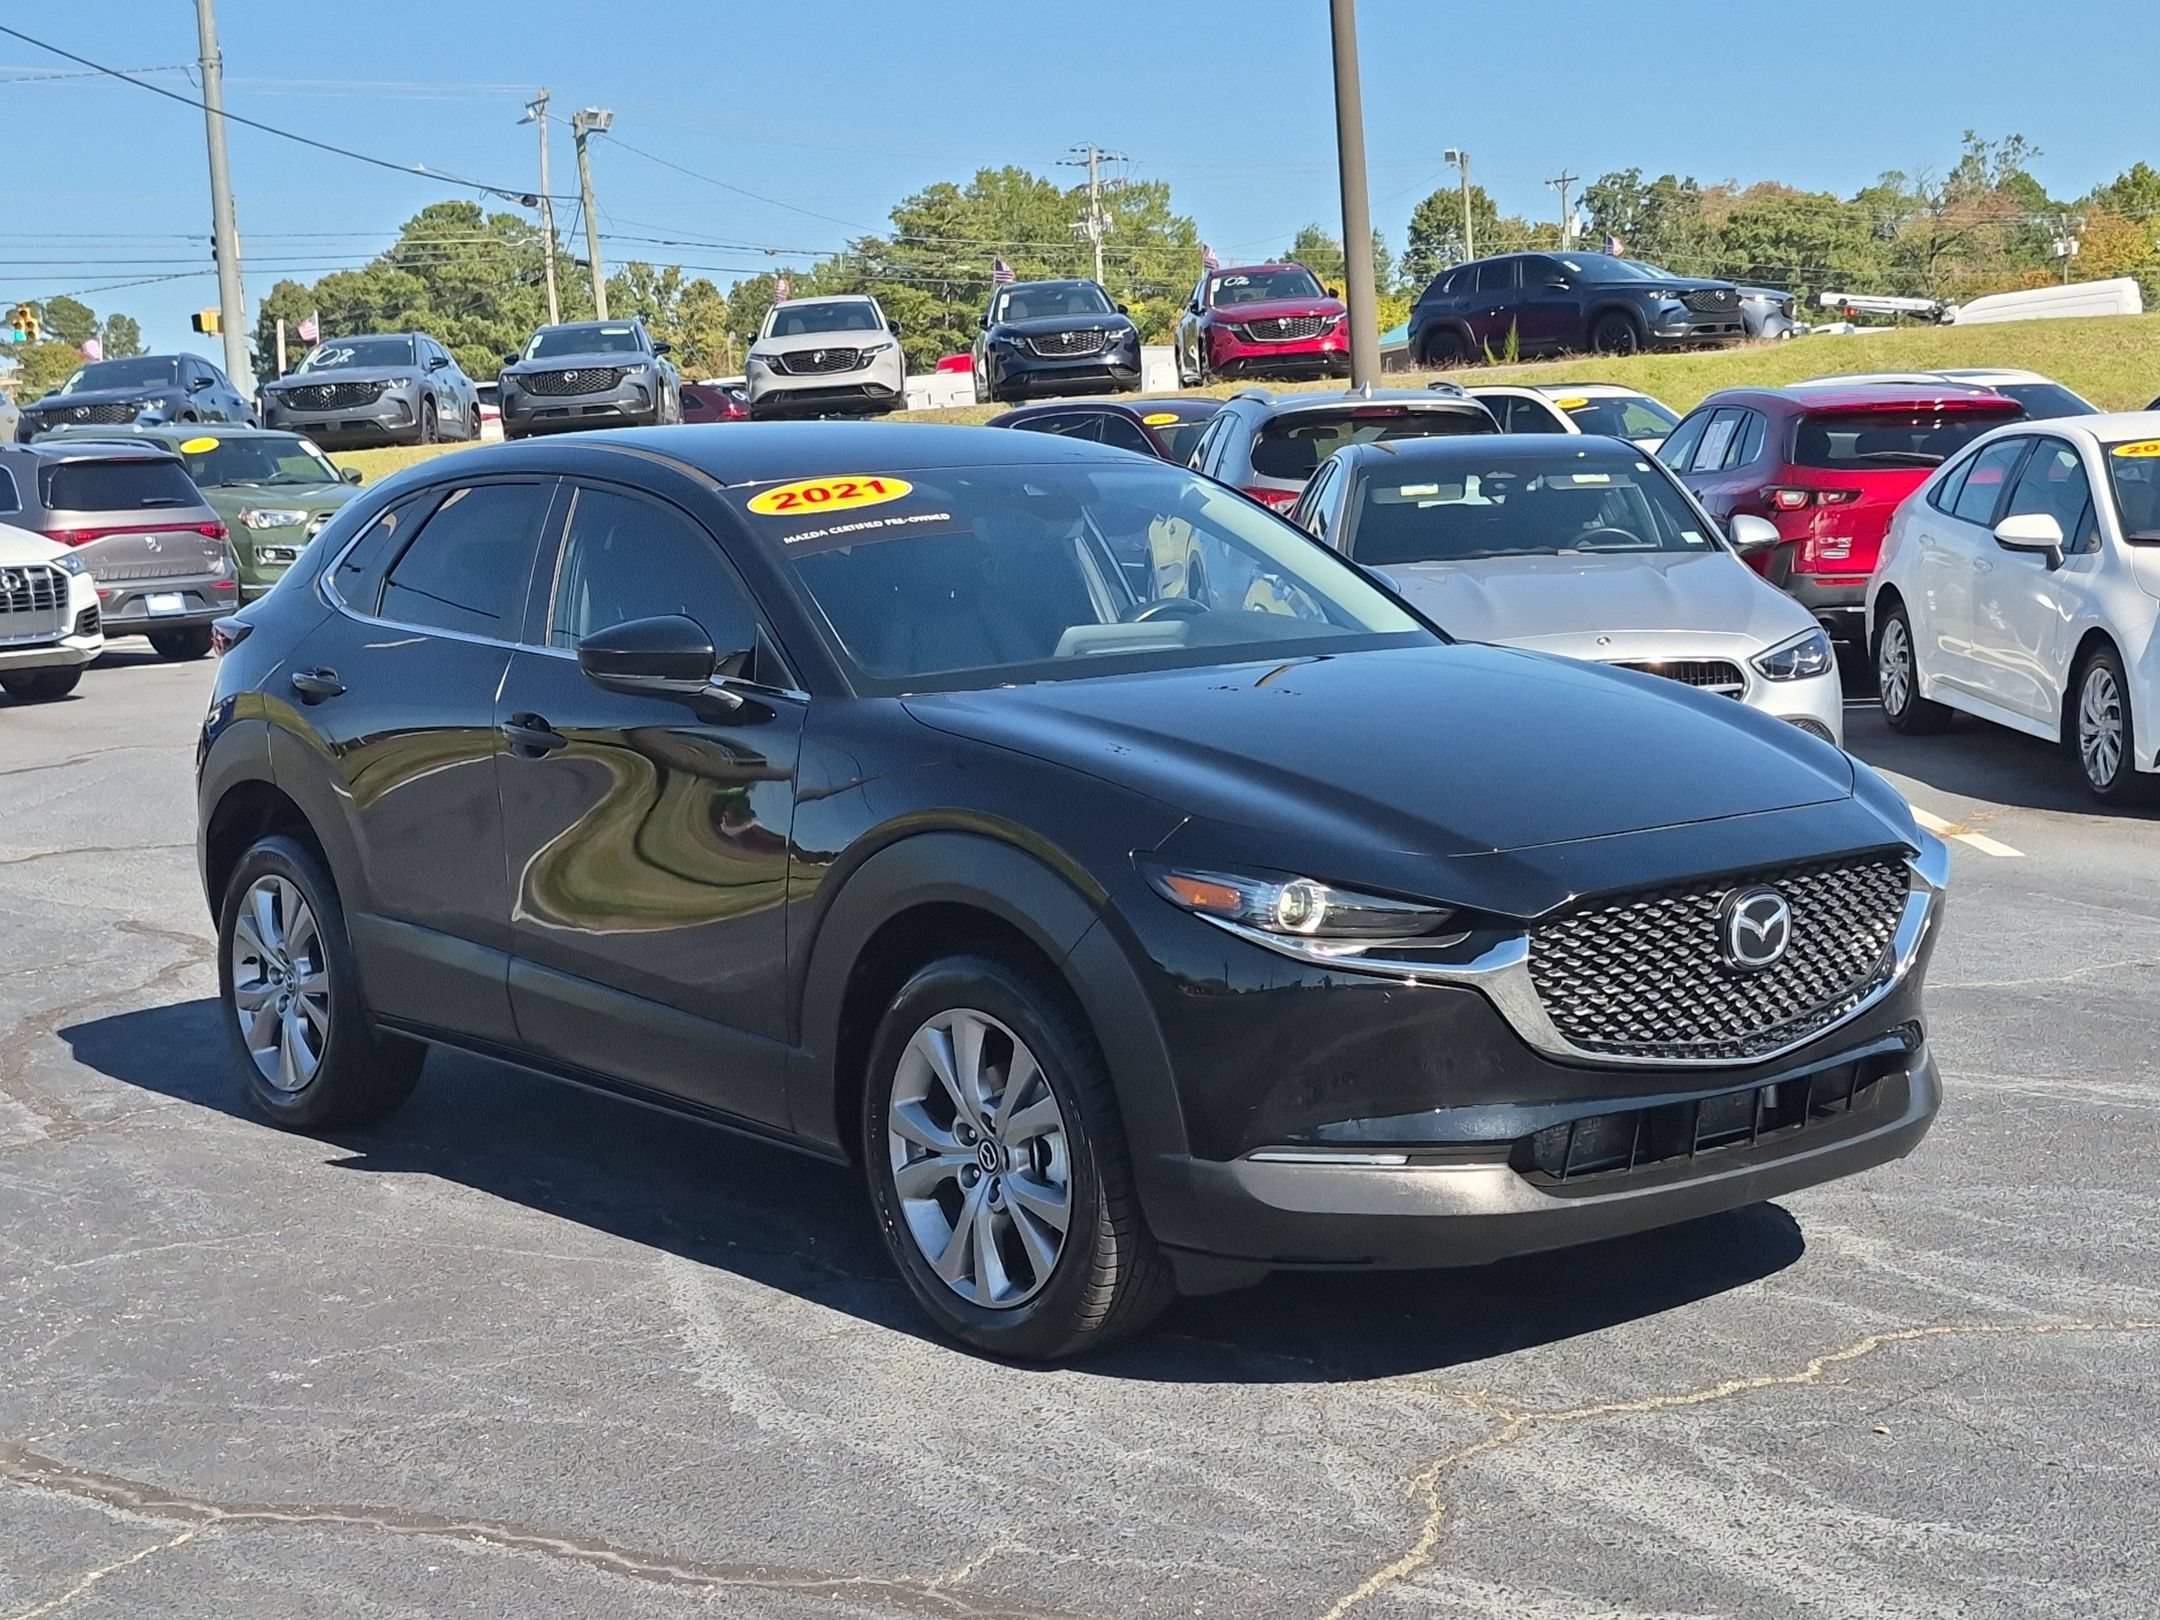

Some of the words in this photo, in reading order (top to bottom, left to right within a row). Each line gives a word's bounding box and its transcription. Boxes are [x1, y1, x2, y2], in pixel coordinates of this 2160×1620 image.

[770, 480, 887, 511] 2021
[783, 530, 828, 544] MAZDA
[829, 520, 883, 534] CERTIFIED
[884, 512, 951, 526] PRE-OWNED
